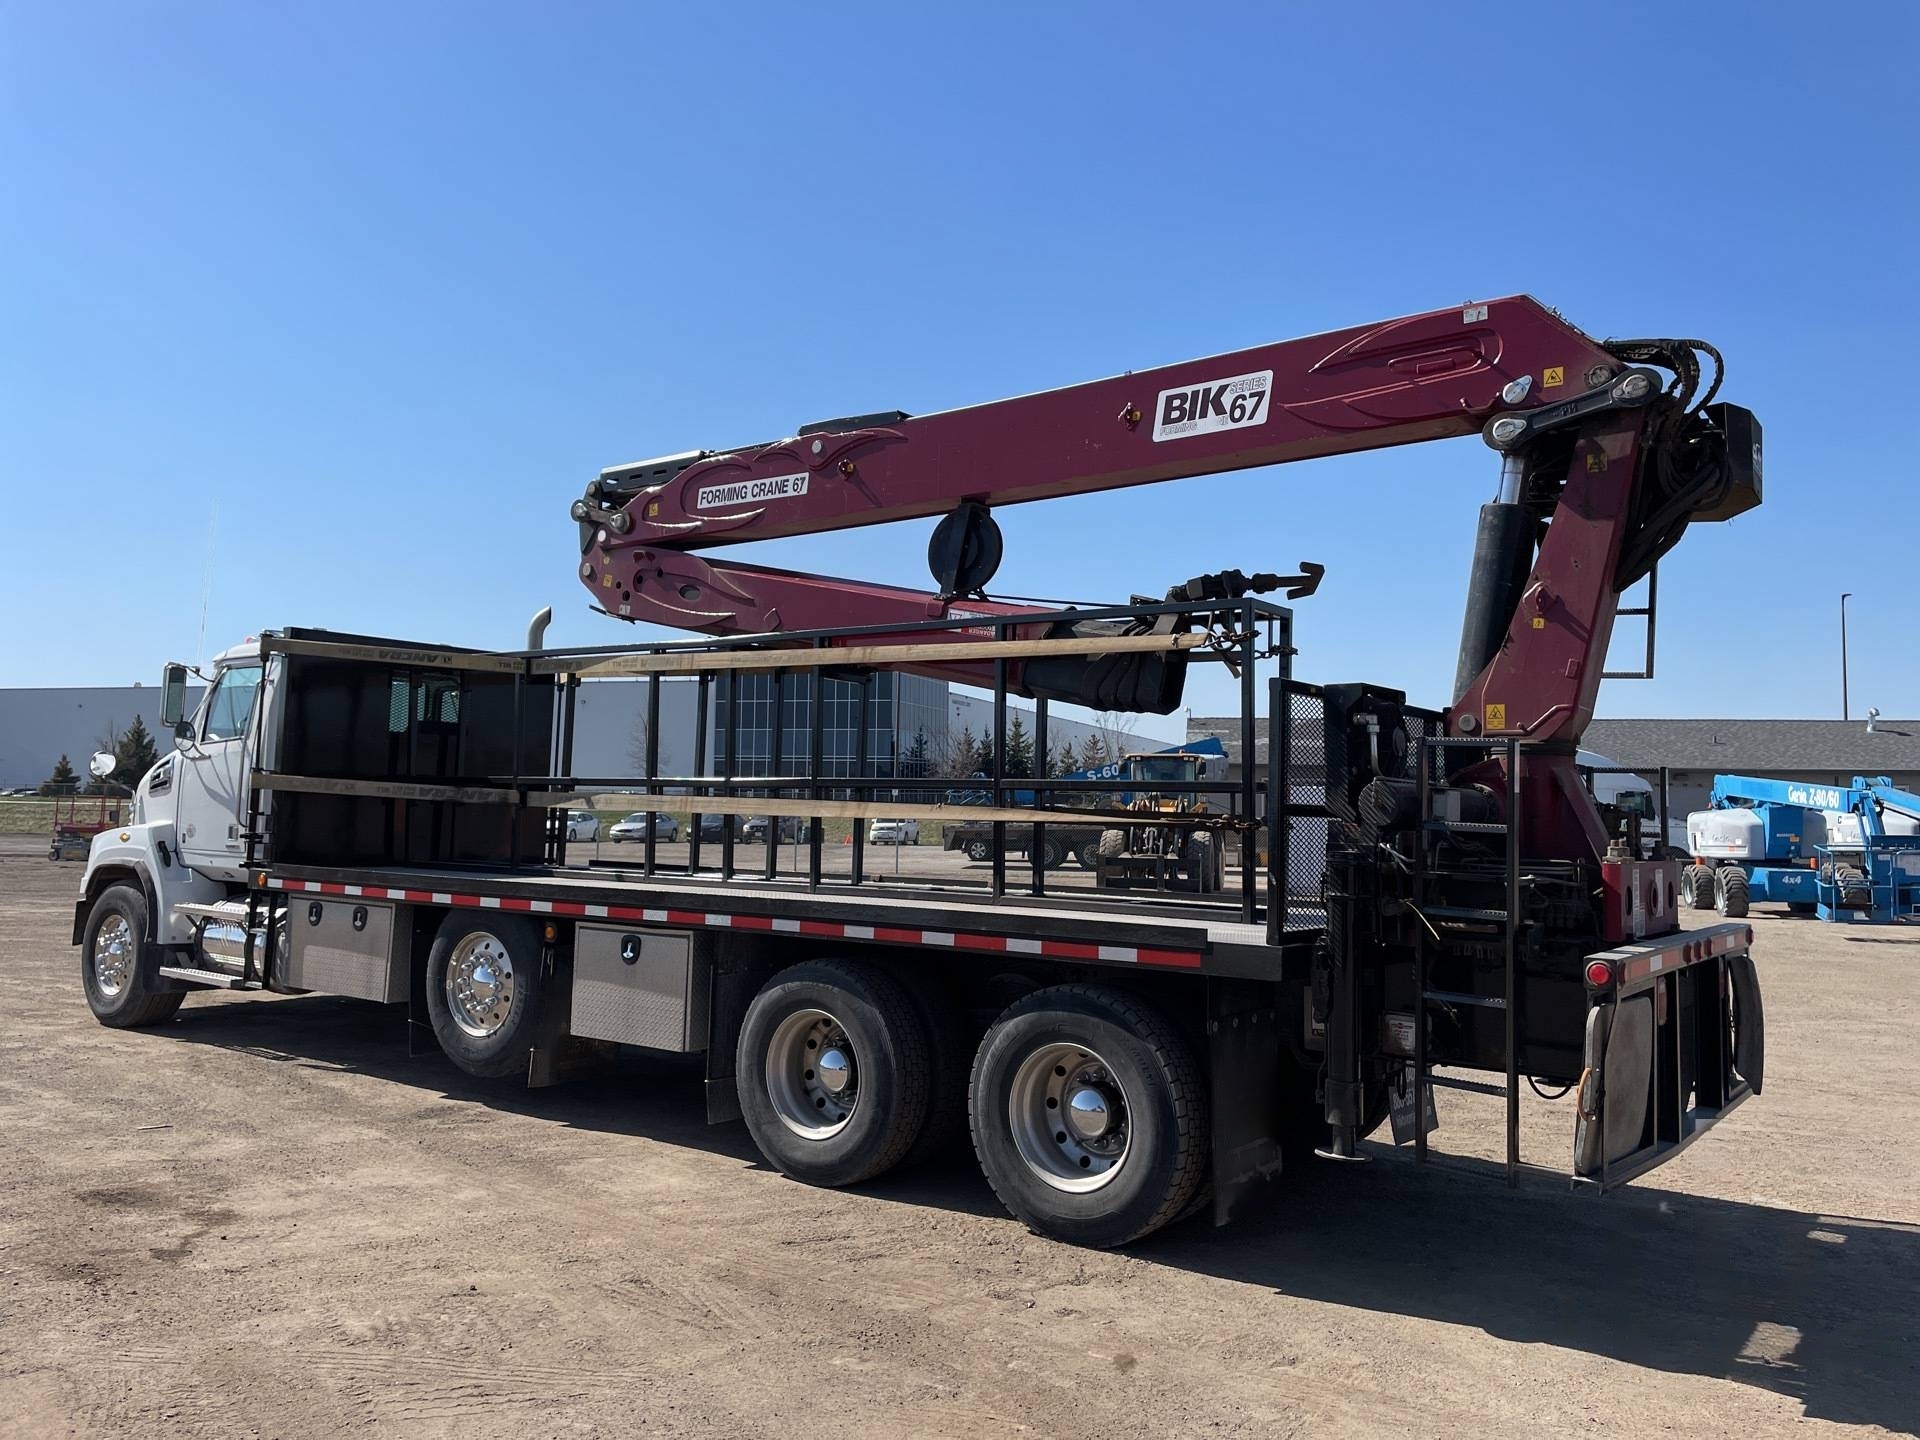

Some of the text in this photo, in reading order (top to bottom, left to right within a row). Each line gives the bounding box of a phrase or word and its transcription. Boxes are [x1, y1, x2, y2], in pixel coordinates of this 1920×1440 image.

[1230, 376, 1267, 394] SERIES
[1162, 383, 1266, 426] BIK 67
[700, 477, 806, 505] FORMING CRANE 67
[1086, 764, 1119, 781] S-60
[1788, 785, 1807, 804] Genie
[1782, 875, 1802, 885] 4x4
